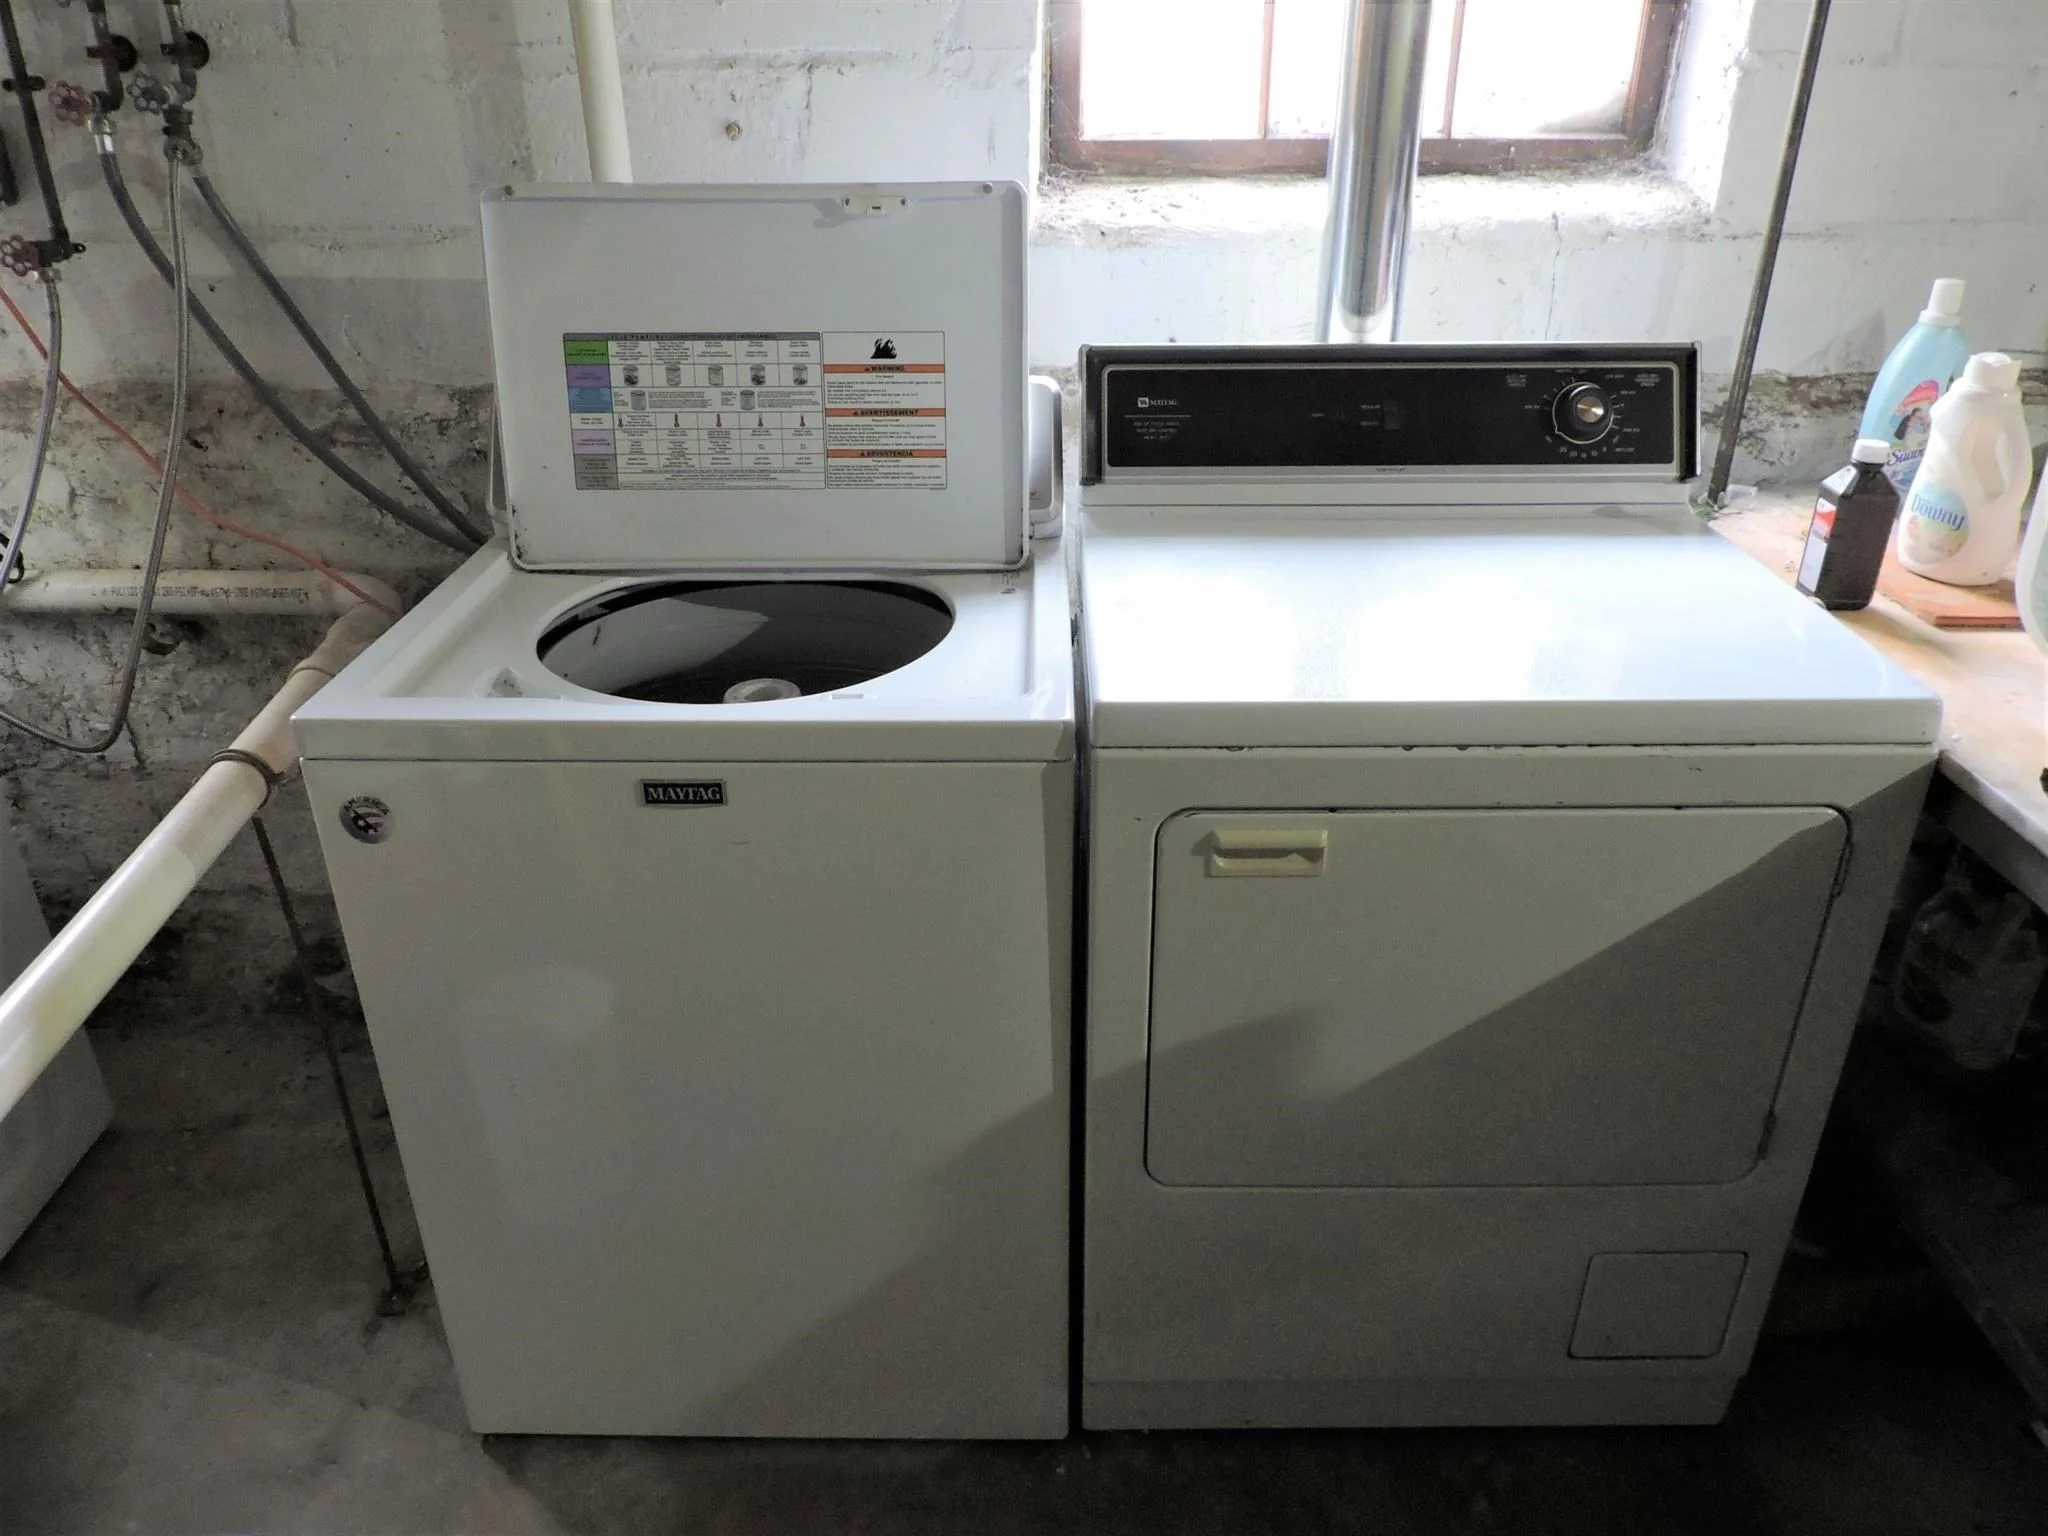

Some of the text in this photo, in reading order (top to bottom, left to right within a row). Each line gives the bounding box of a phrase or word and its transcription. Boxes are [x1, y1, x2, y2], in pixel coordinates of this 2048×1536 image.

[1910, 494, 1965, 531] Downy
[646, 786, 721, 801] MAYTAG
[343, 795, 389, 815] AMERICA
